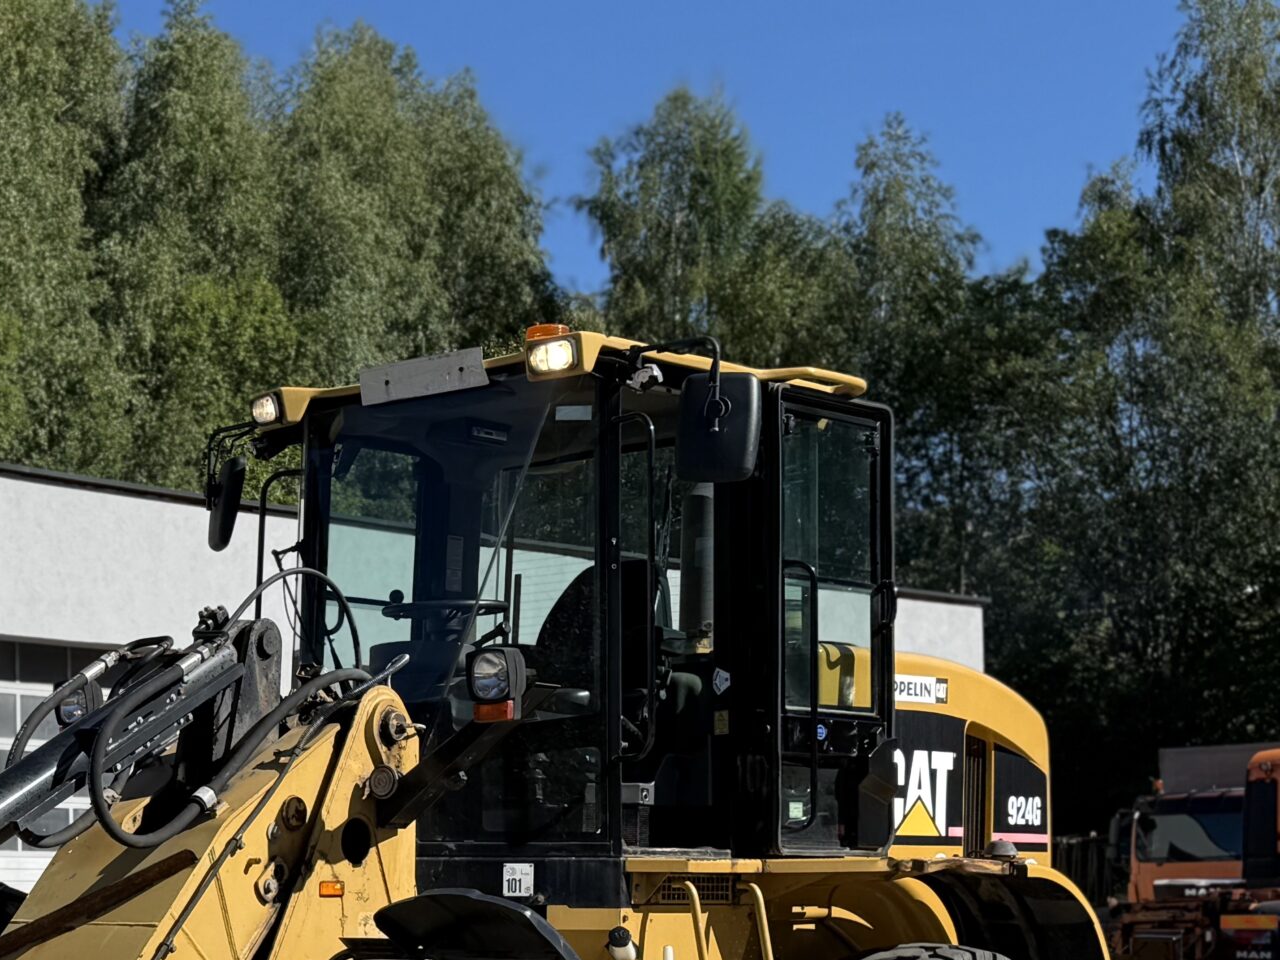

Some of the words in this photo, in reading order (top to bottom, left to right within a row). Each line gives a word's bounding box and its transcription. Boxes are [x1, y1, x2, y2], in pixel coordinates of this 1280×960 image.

[1008, 796, 1041, 826] 924G
[506, 878, 522, 893] 101
[1236, 950, 1272, 960] MAN
